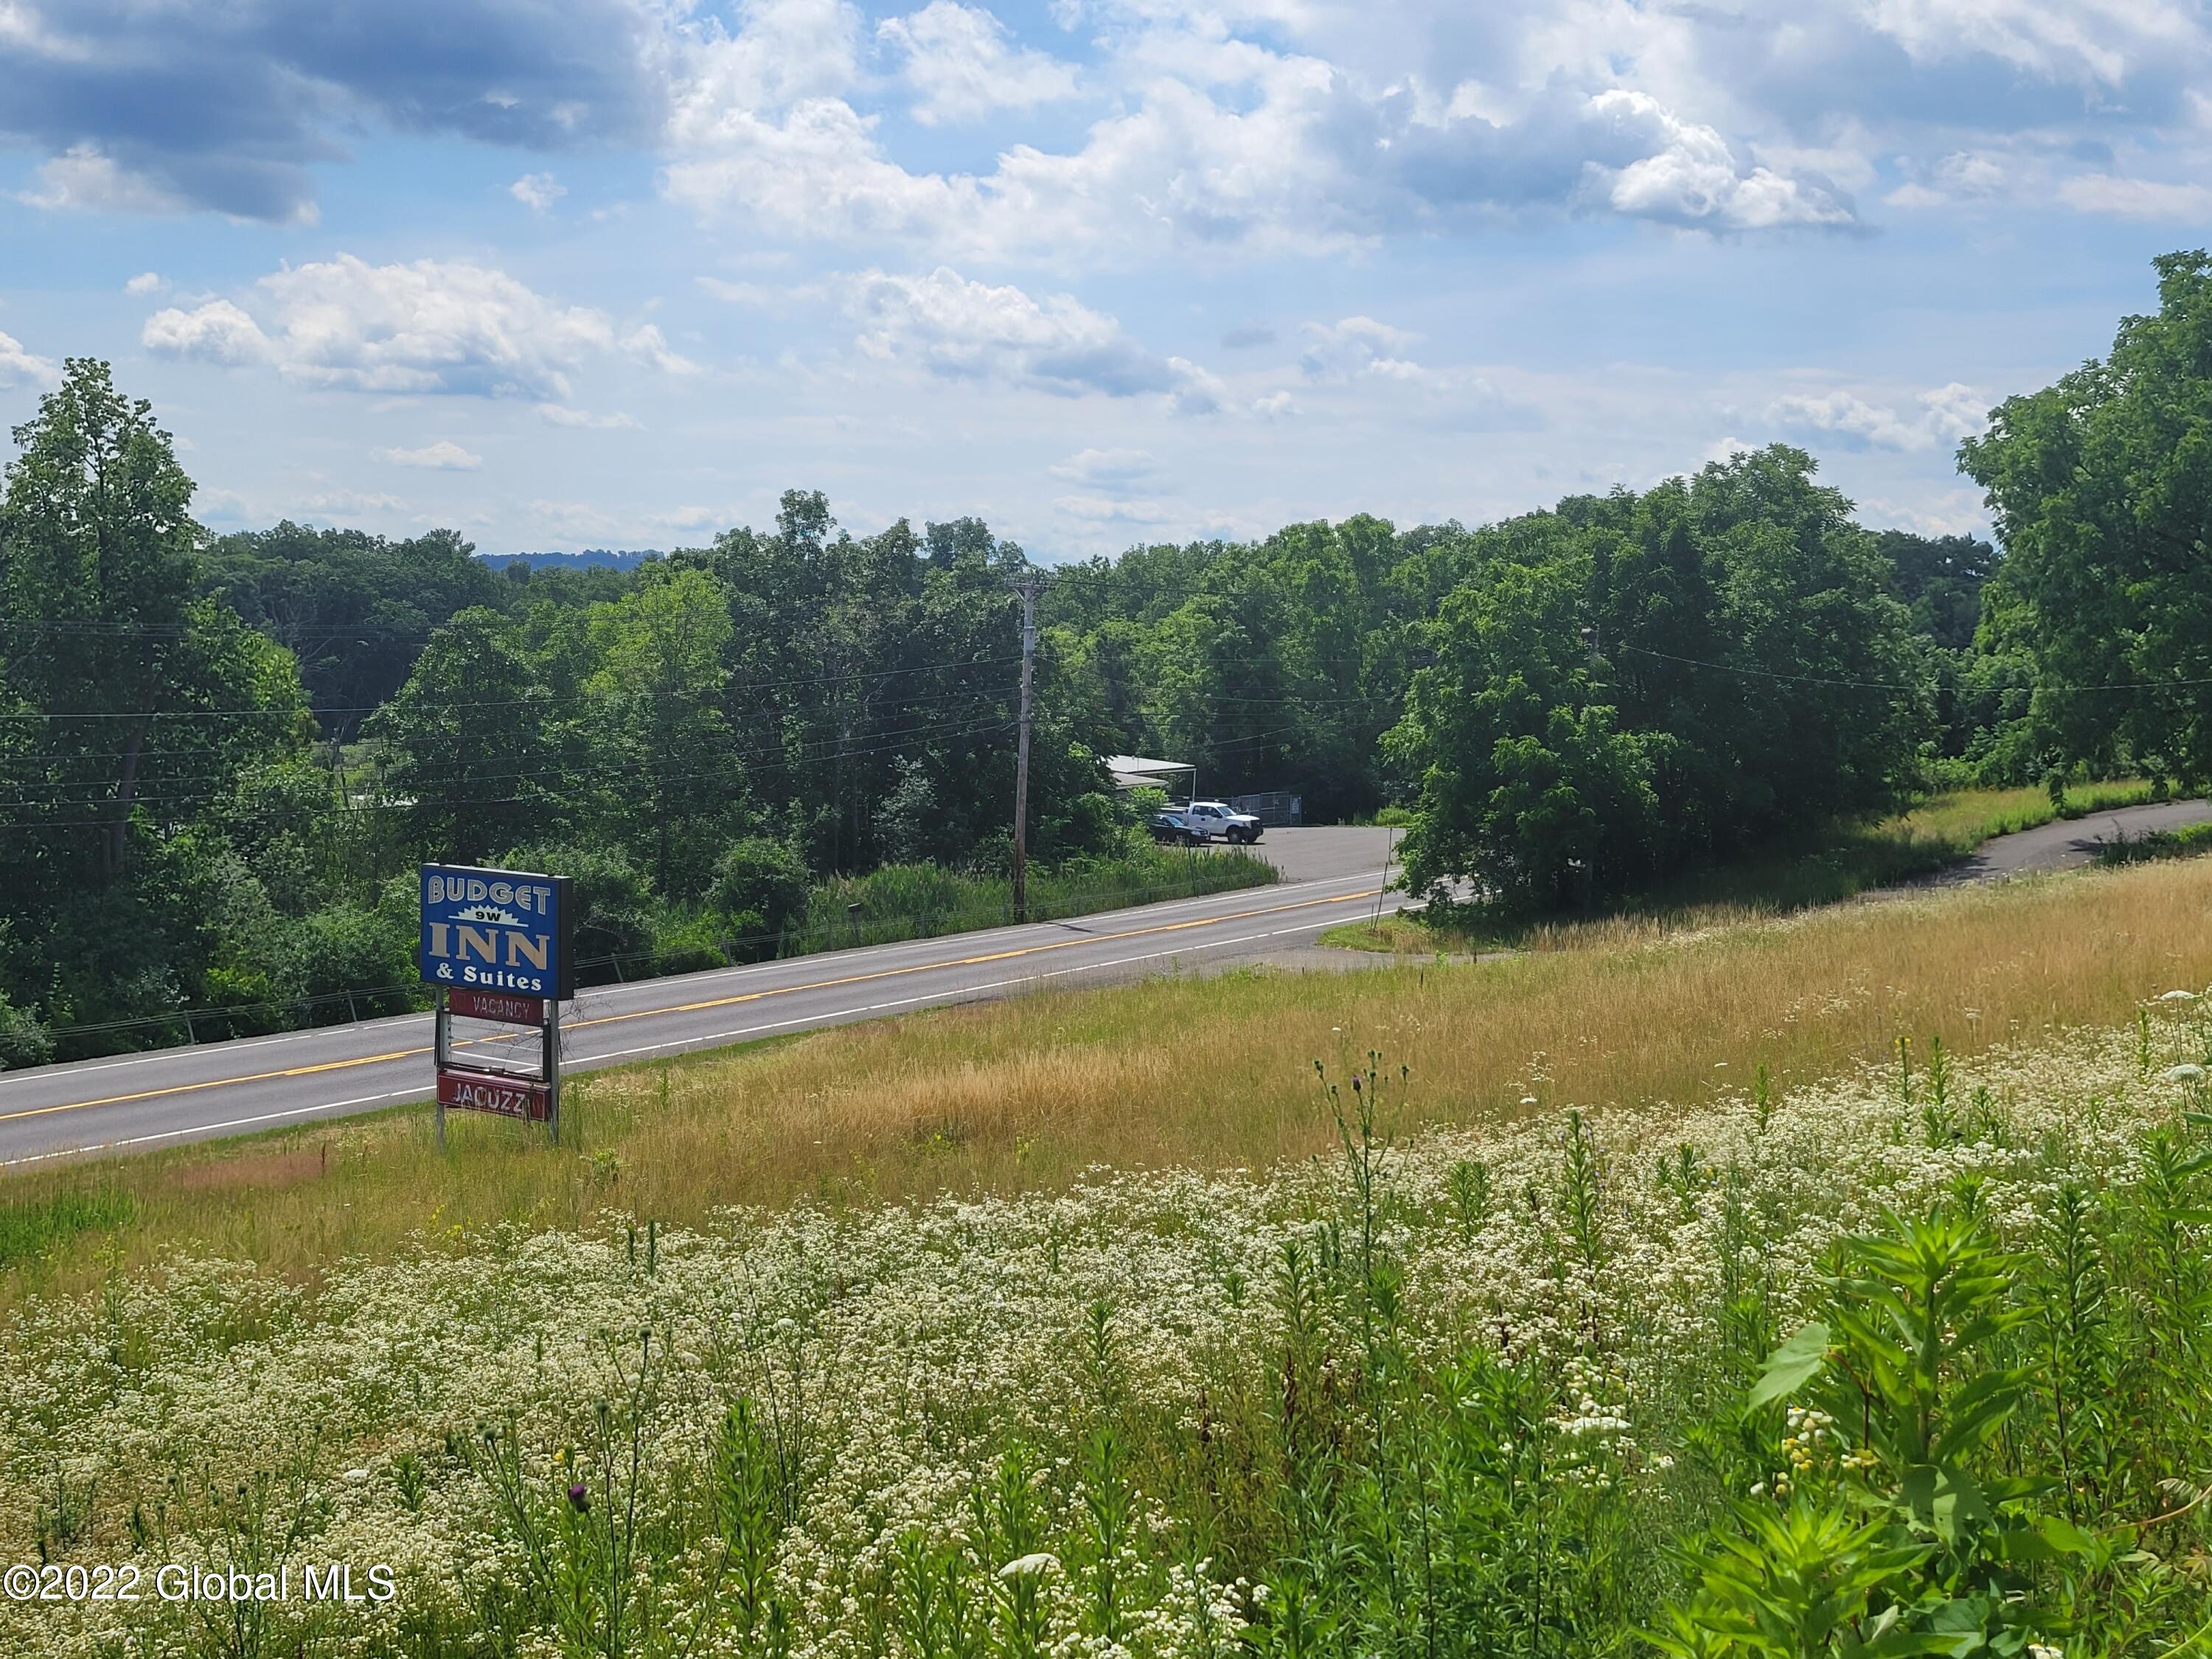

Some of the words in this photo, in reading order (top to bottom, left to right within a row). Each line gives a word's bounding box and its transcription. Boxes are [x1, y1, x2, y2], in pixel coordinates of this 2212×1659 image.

[428, 875, 551, 915] BUDGET
[476, 911, 501, 922] 9W
[428, 922, 550, 970] INN
[437, 962, 454, 979] &
[463, 965, 542, 991] Suites
[473, 996, 529, 1019] VACANCY
[452, 1082, 532, 1113] JACUZZ
